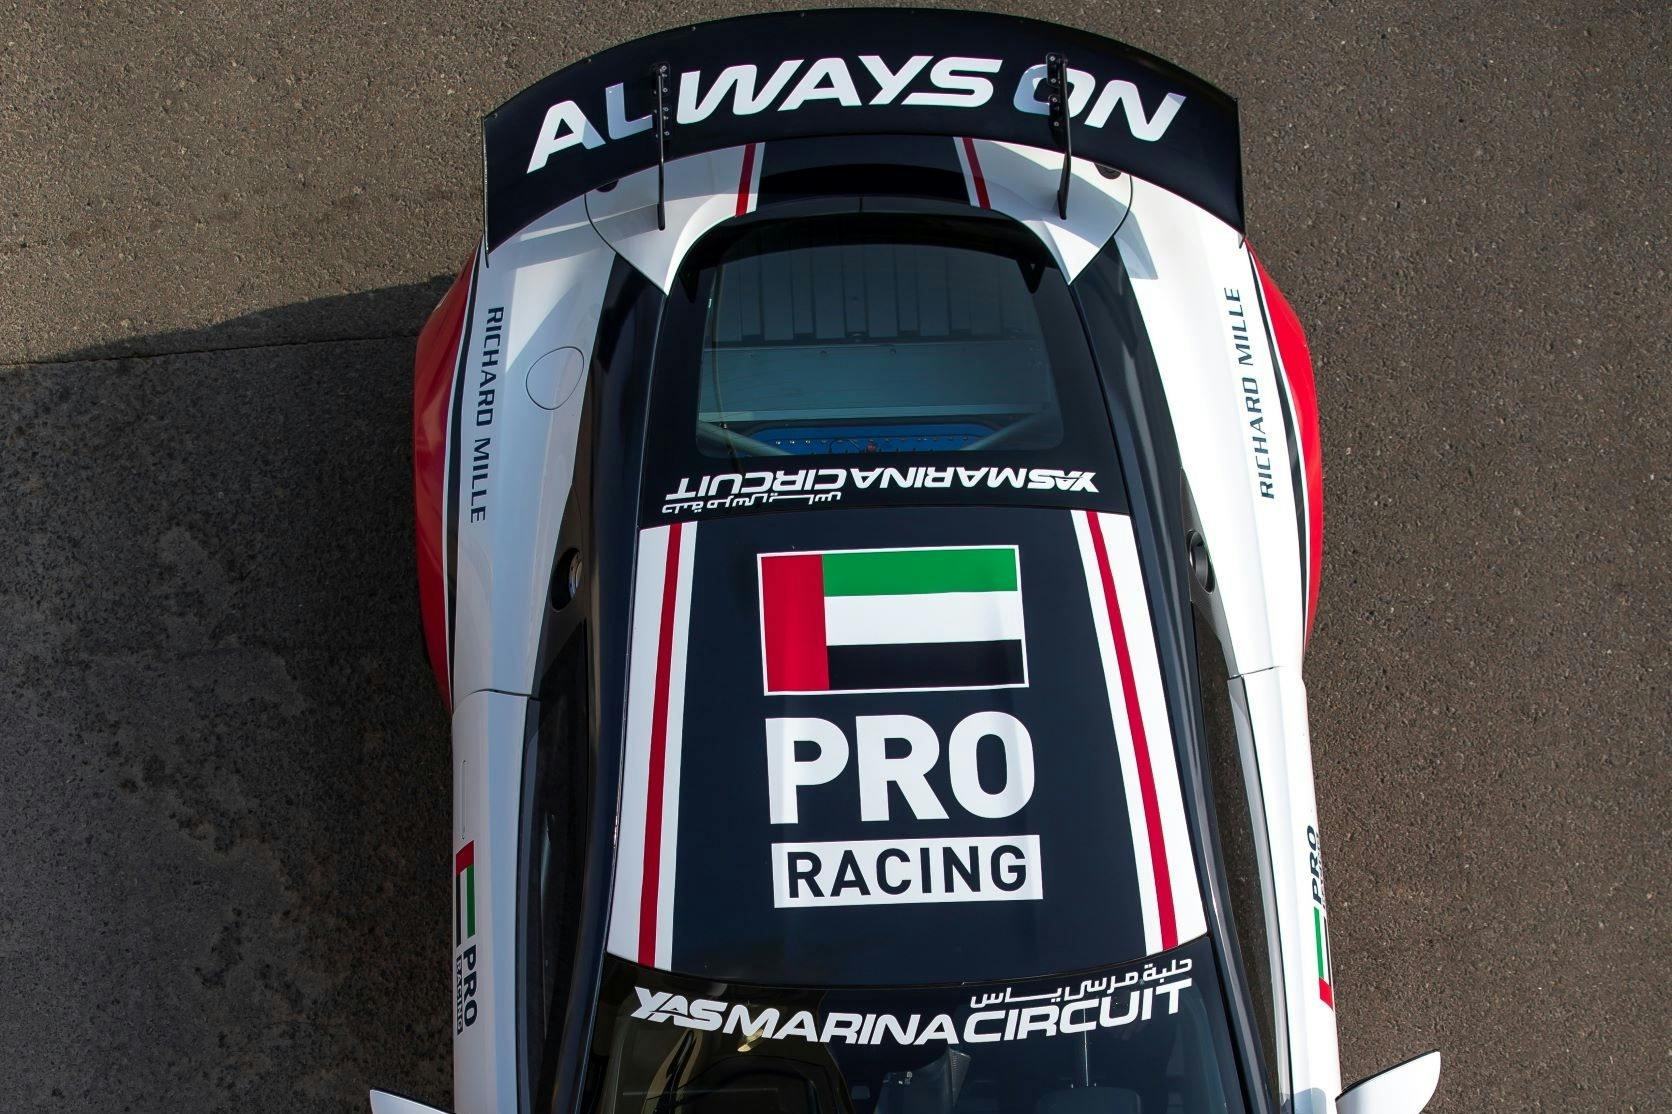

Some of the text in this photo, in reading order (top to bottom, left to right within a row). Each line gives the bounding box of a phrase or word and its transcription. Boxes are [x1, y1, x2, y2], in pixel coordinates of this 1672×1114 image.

[526, 55, 1187, 174] ALWAYS ON
[470, 306, 505, 524] RICHARD MILLE
[1224, 287, 1275, 499] RICHARD MILLE
[765, 711, 1035, 824] PRO
[787, 844, 1027, 899] RACING
[1307, 825, 1322, 905] PRO
[463, 944, 478, 1028] PRO
